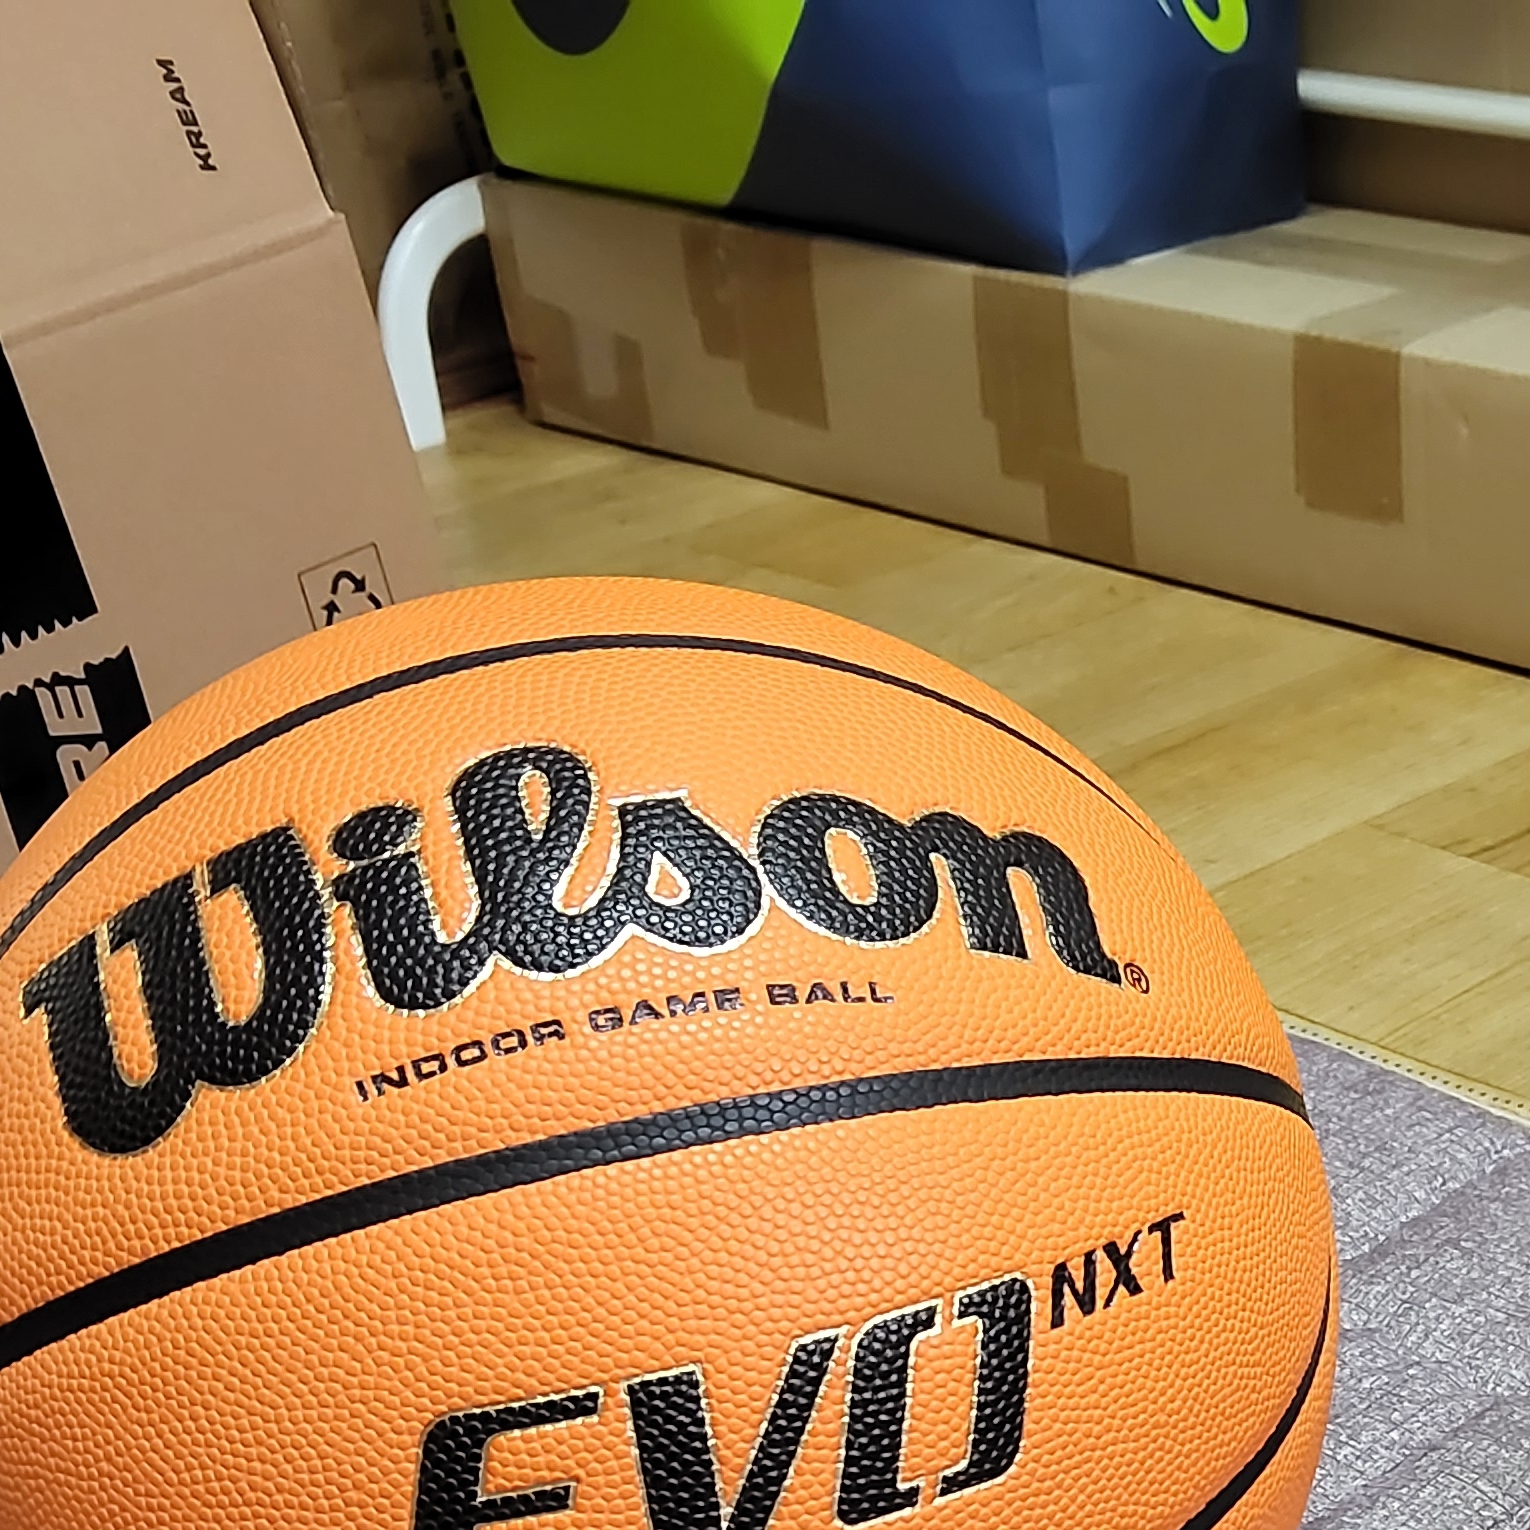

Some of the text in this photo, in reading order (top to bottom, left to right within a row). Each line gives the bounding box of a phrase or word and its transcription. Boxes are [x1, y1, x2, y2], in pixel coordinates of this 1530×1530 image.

[155, 58, 218, 171] KREAM
[20, 742, 1128, 1157] Wilson
[354, 979, 896, 1103] INDOOR GAME BALL
[1048, 1209, 1187, 1331] NXT
